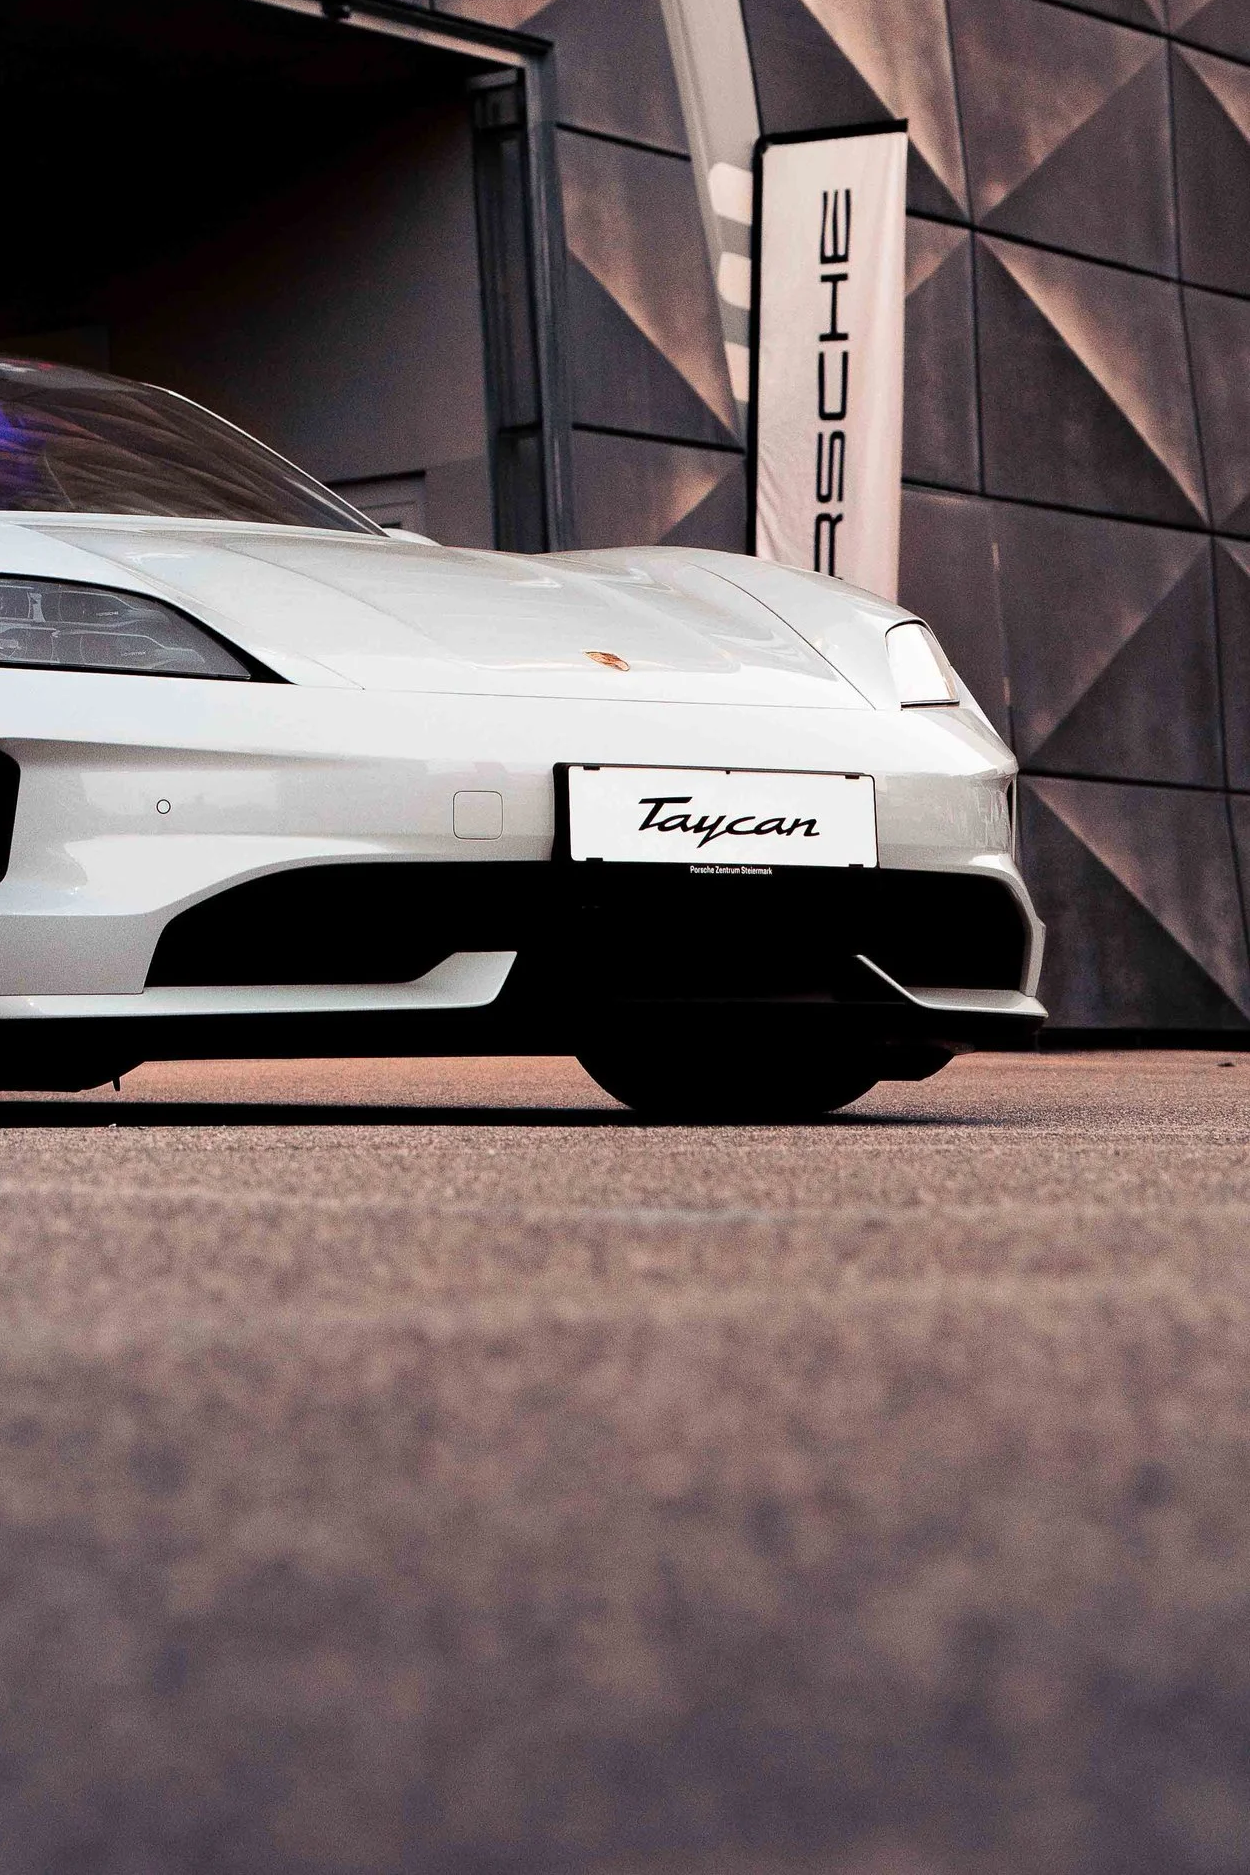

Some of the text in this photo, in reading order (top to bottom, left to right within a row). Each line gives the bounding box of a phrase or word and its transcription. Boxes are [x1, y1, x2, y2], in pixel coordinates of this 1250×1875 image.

[638, 796, 820, 849] Taycan
[690, 865, 772, 875] Porsche Zentrum Steiermark
